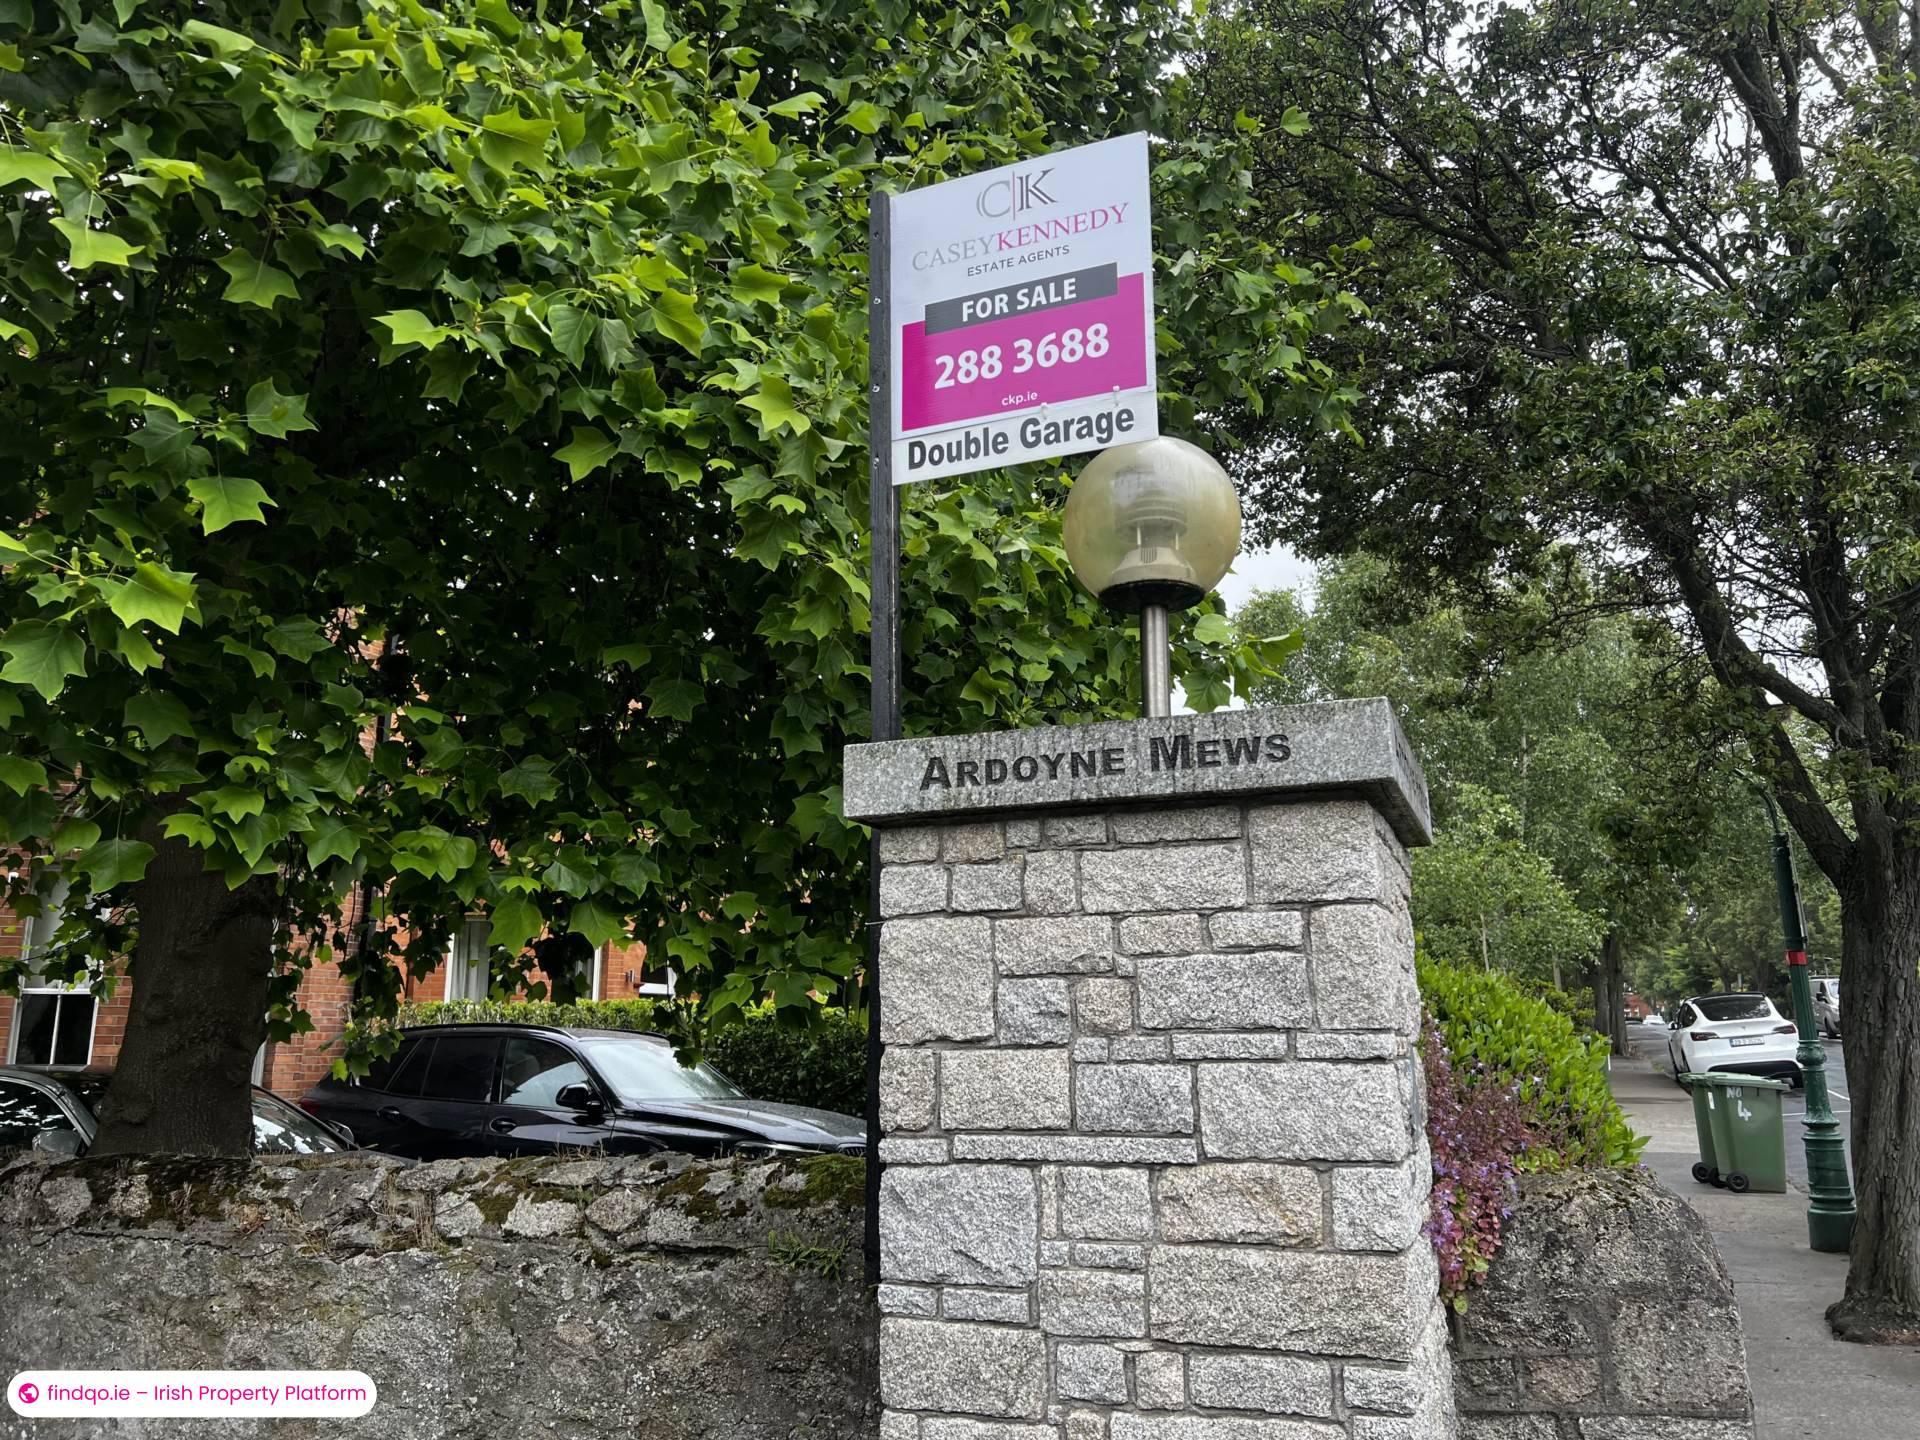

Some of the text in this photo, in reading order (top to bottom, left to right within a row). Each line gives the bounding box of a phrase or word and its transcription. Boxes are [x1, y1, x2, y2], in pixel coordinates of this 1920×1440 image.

[967, 244, 1070, 277] ESTATE AGENTS
[962, 278, 1076, 322] FOR SALE
[934, 322, 1109, 390] 288 3688
[1001, 390, 1038, 407] ckp.ie
[908, 407, 1134, 470] Double Garage
[919, 733, 1292, 791] ARDOYNE MEWS
